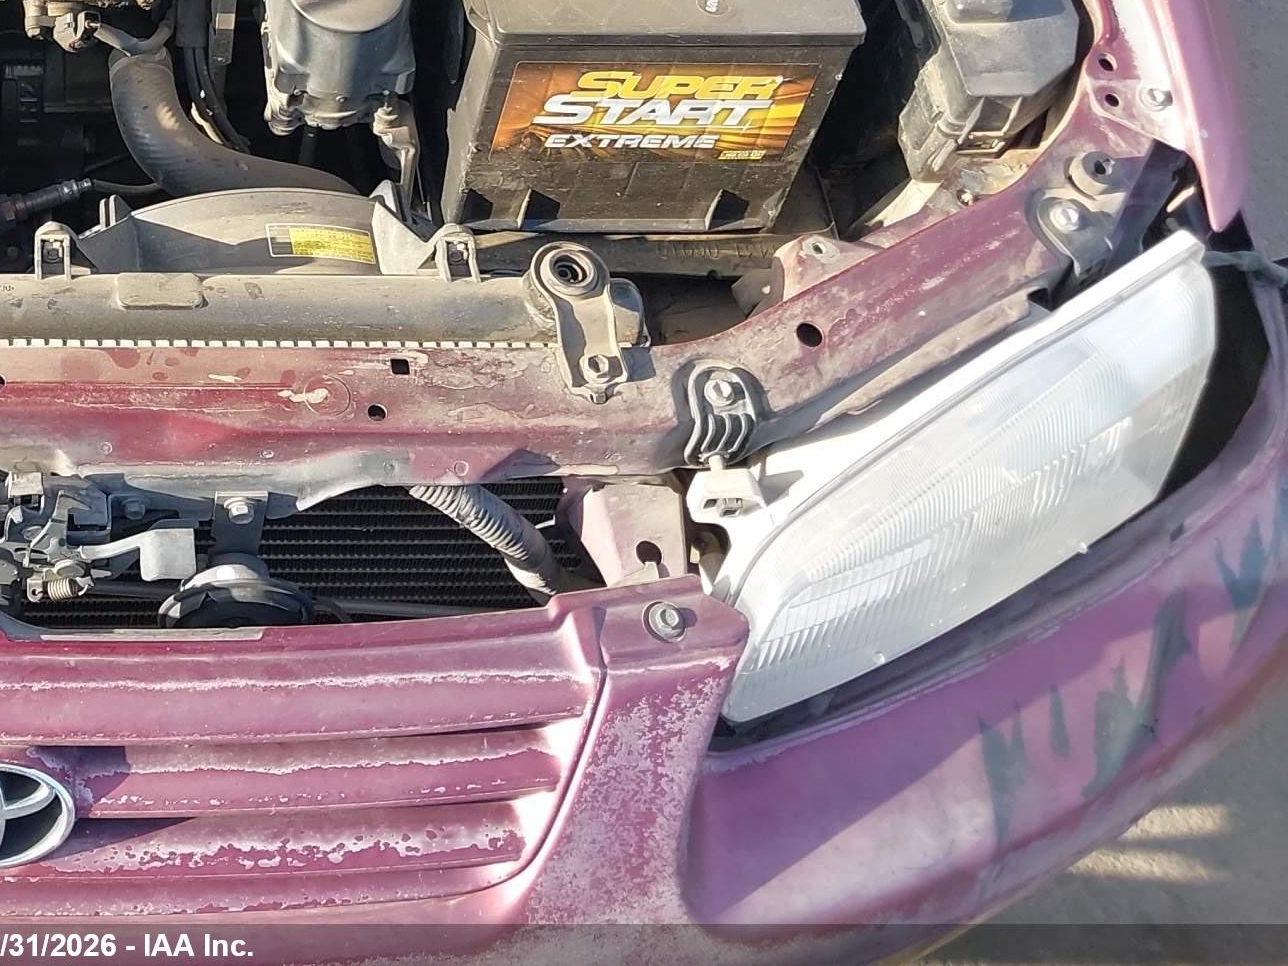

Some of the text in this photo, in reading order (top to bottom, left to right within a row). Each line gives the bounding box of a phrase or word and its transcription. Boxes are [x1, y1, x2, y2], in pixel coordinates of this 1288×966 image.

[576, 71, 782, 99] SUPER
[532, 94, 773, 126] START
[544, 134, 719, 149] EXTREME
